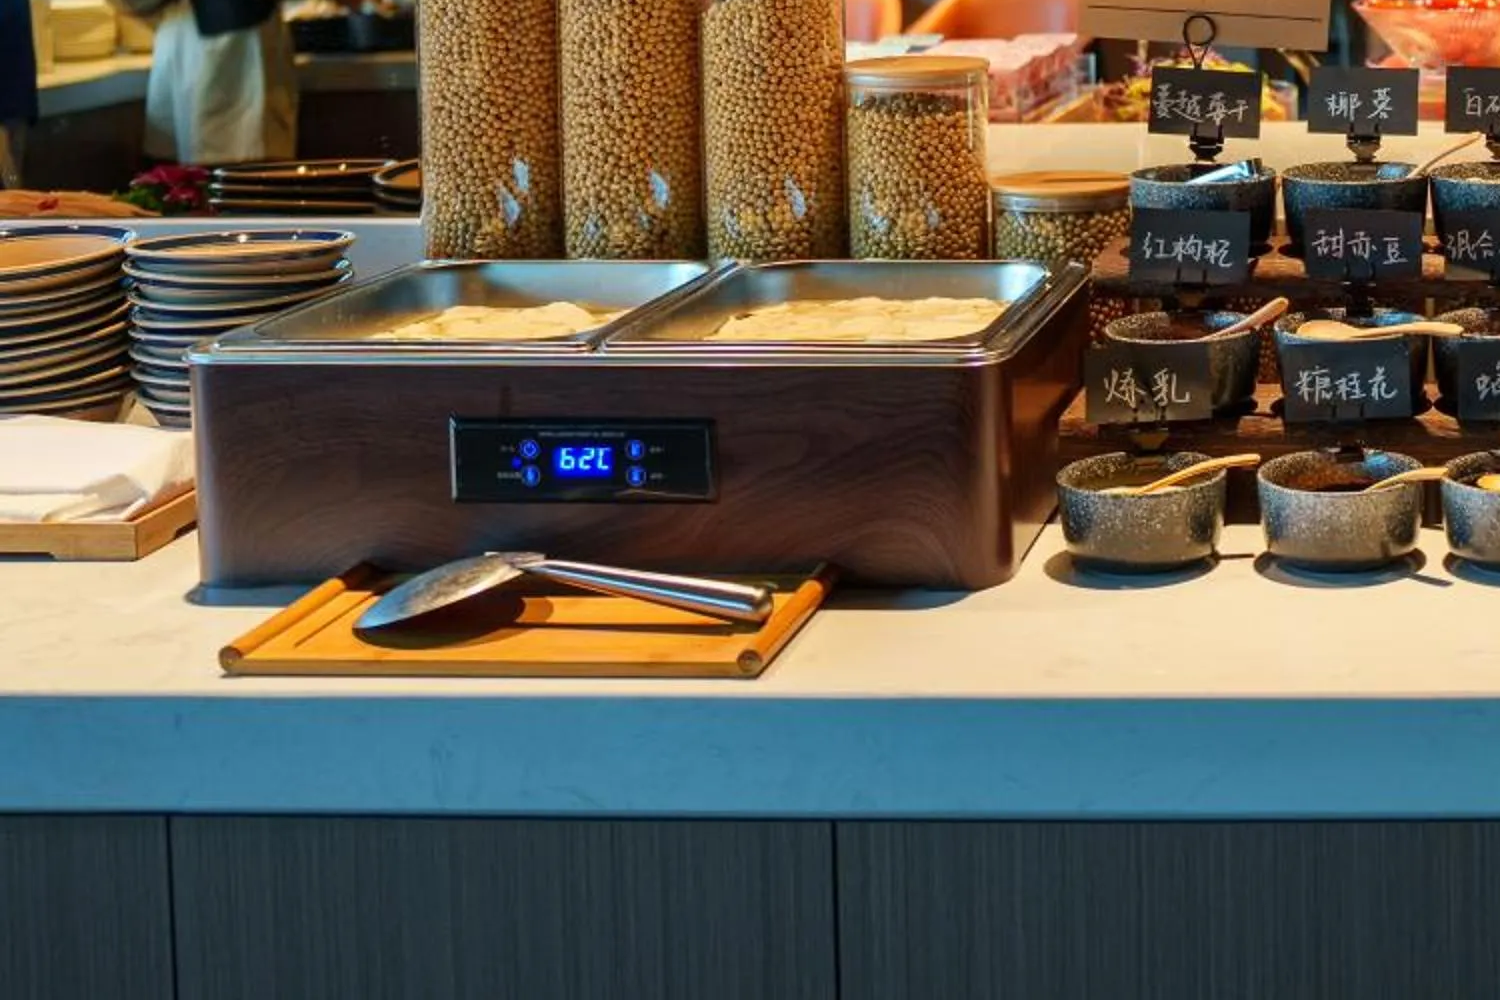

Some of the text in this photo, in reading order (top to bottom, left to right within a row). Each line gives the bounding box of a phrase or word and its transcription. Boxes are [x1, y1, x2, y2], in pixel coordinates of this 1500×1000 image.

[1153, 83, 1249, 125] 蔓越莓干
[1143, 232, 1233, 268] 红枸杞
[1104, 367, 1191, 408] 炼乳
[1296, 365, 1399, 405] 糖桂花
